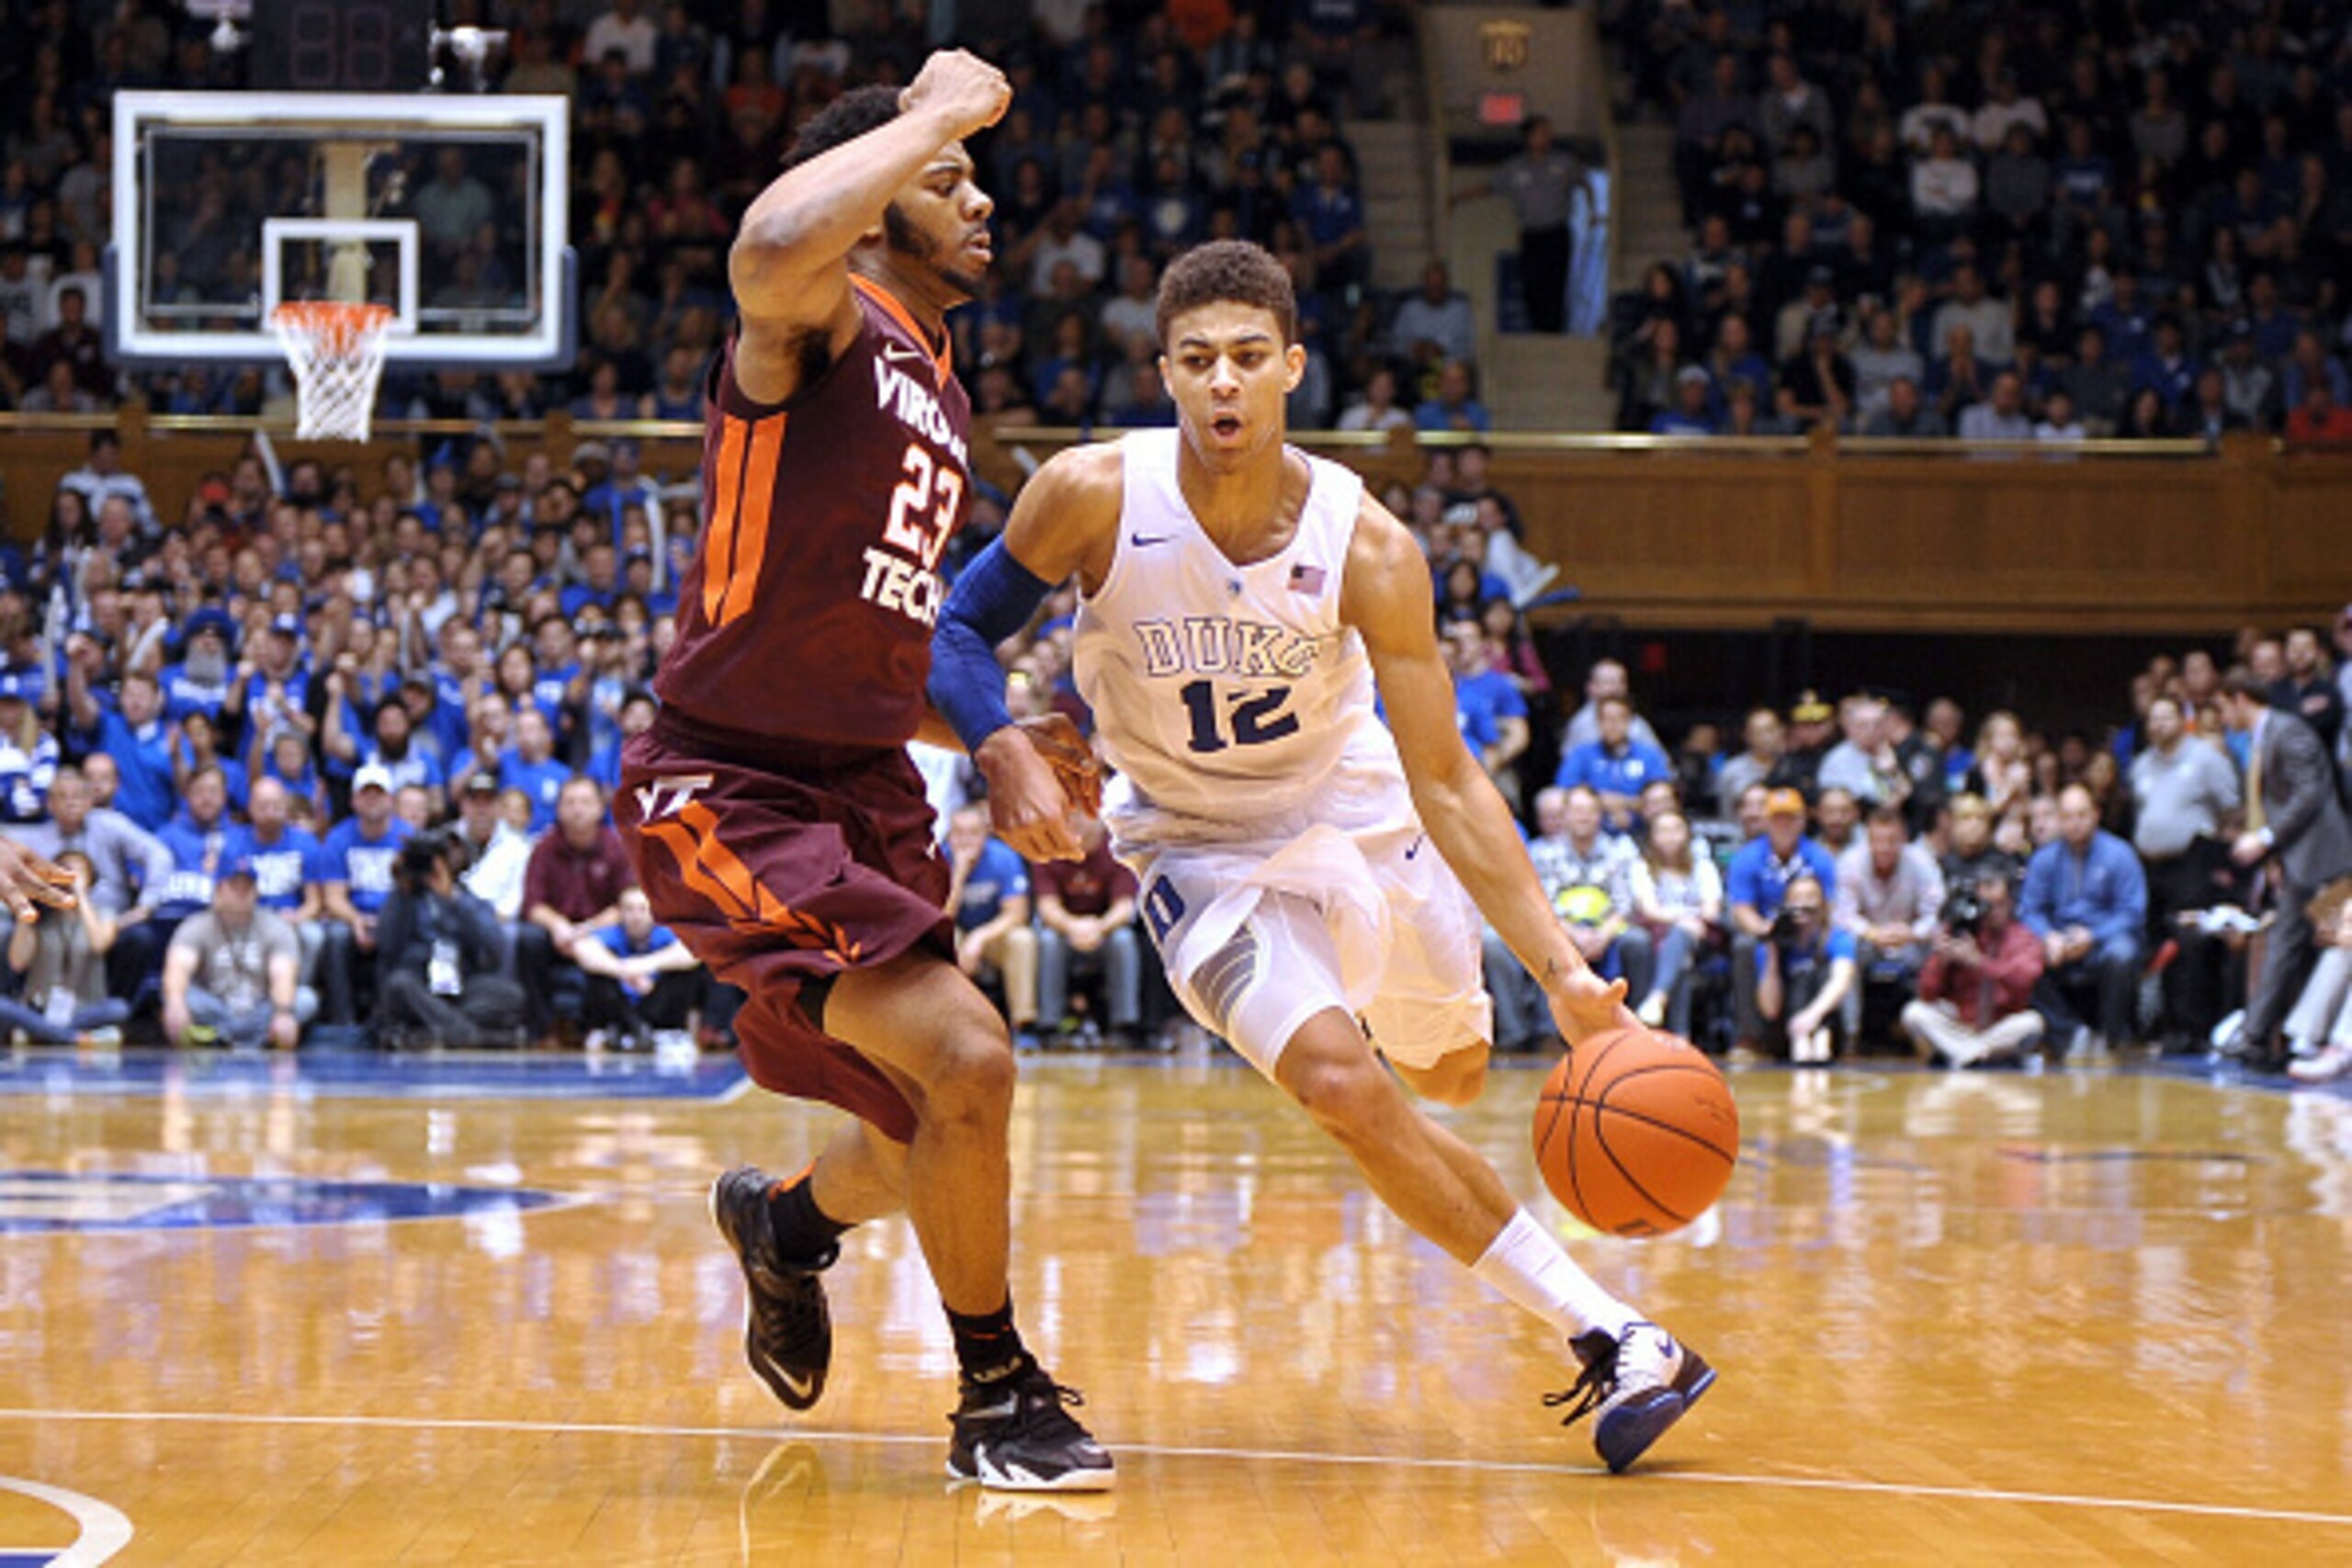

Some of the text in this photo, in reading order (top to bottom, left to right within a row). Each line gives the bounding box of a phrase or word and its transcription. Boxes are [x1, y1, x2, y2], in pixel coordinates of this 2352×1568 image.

[883, 444, 963, 570] 23
[1134, 616, 1320, 678] DUKE
[1180, 680, 1300, 753] 12
[633, 773, 715, 820] VT
